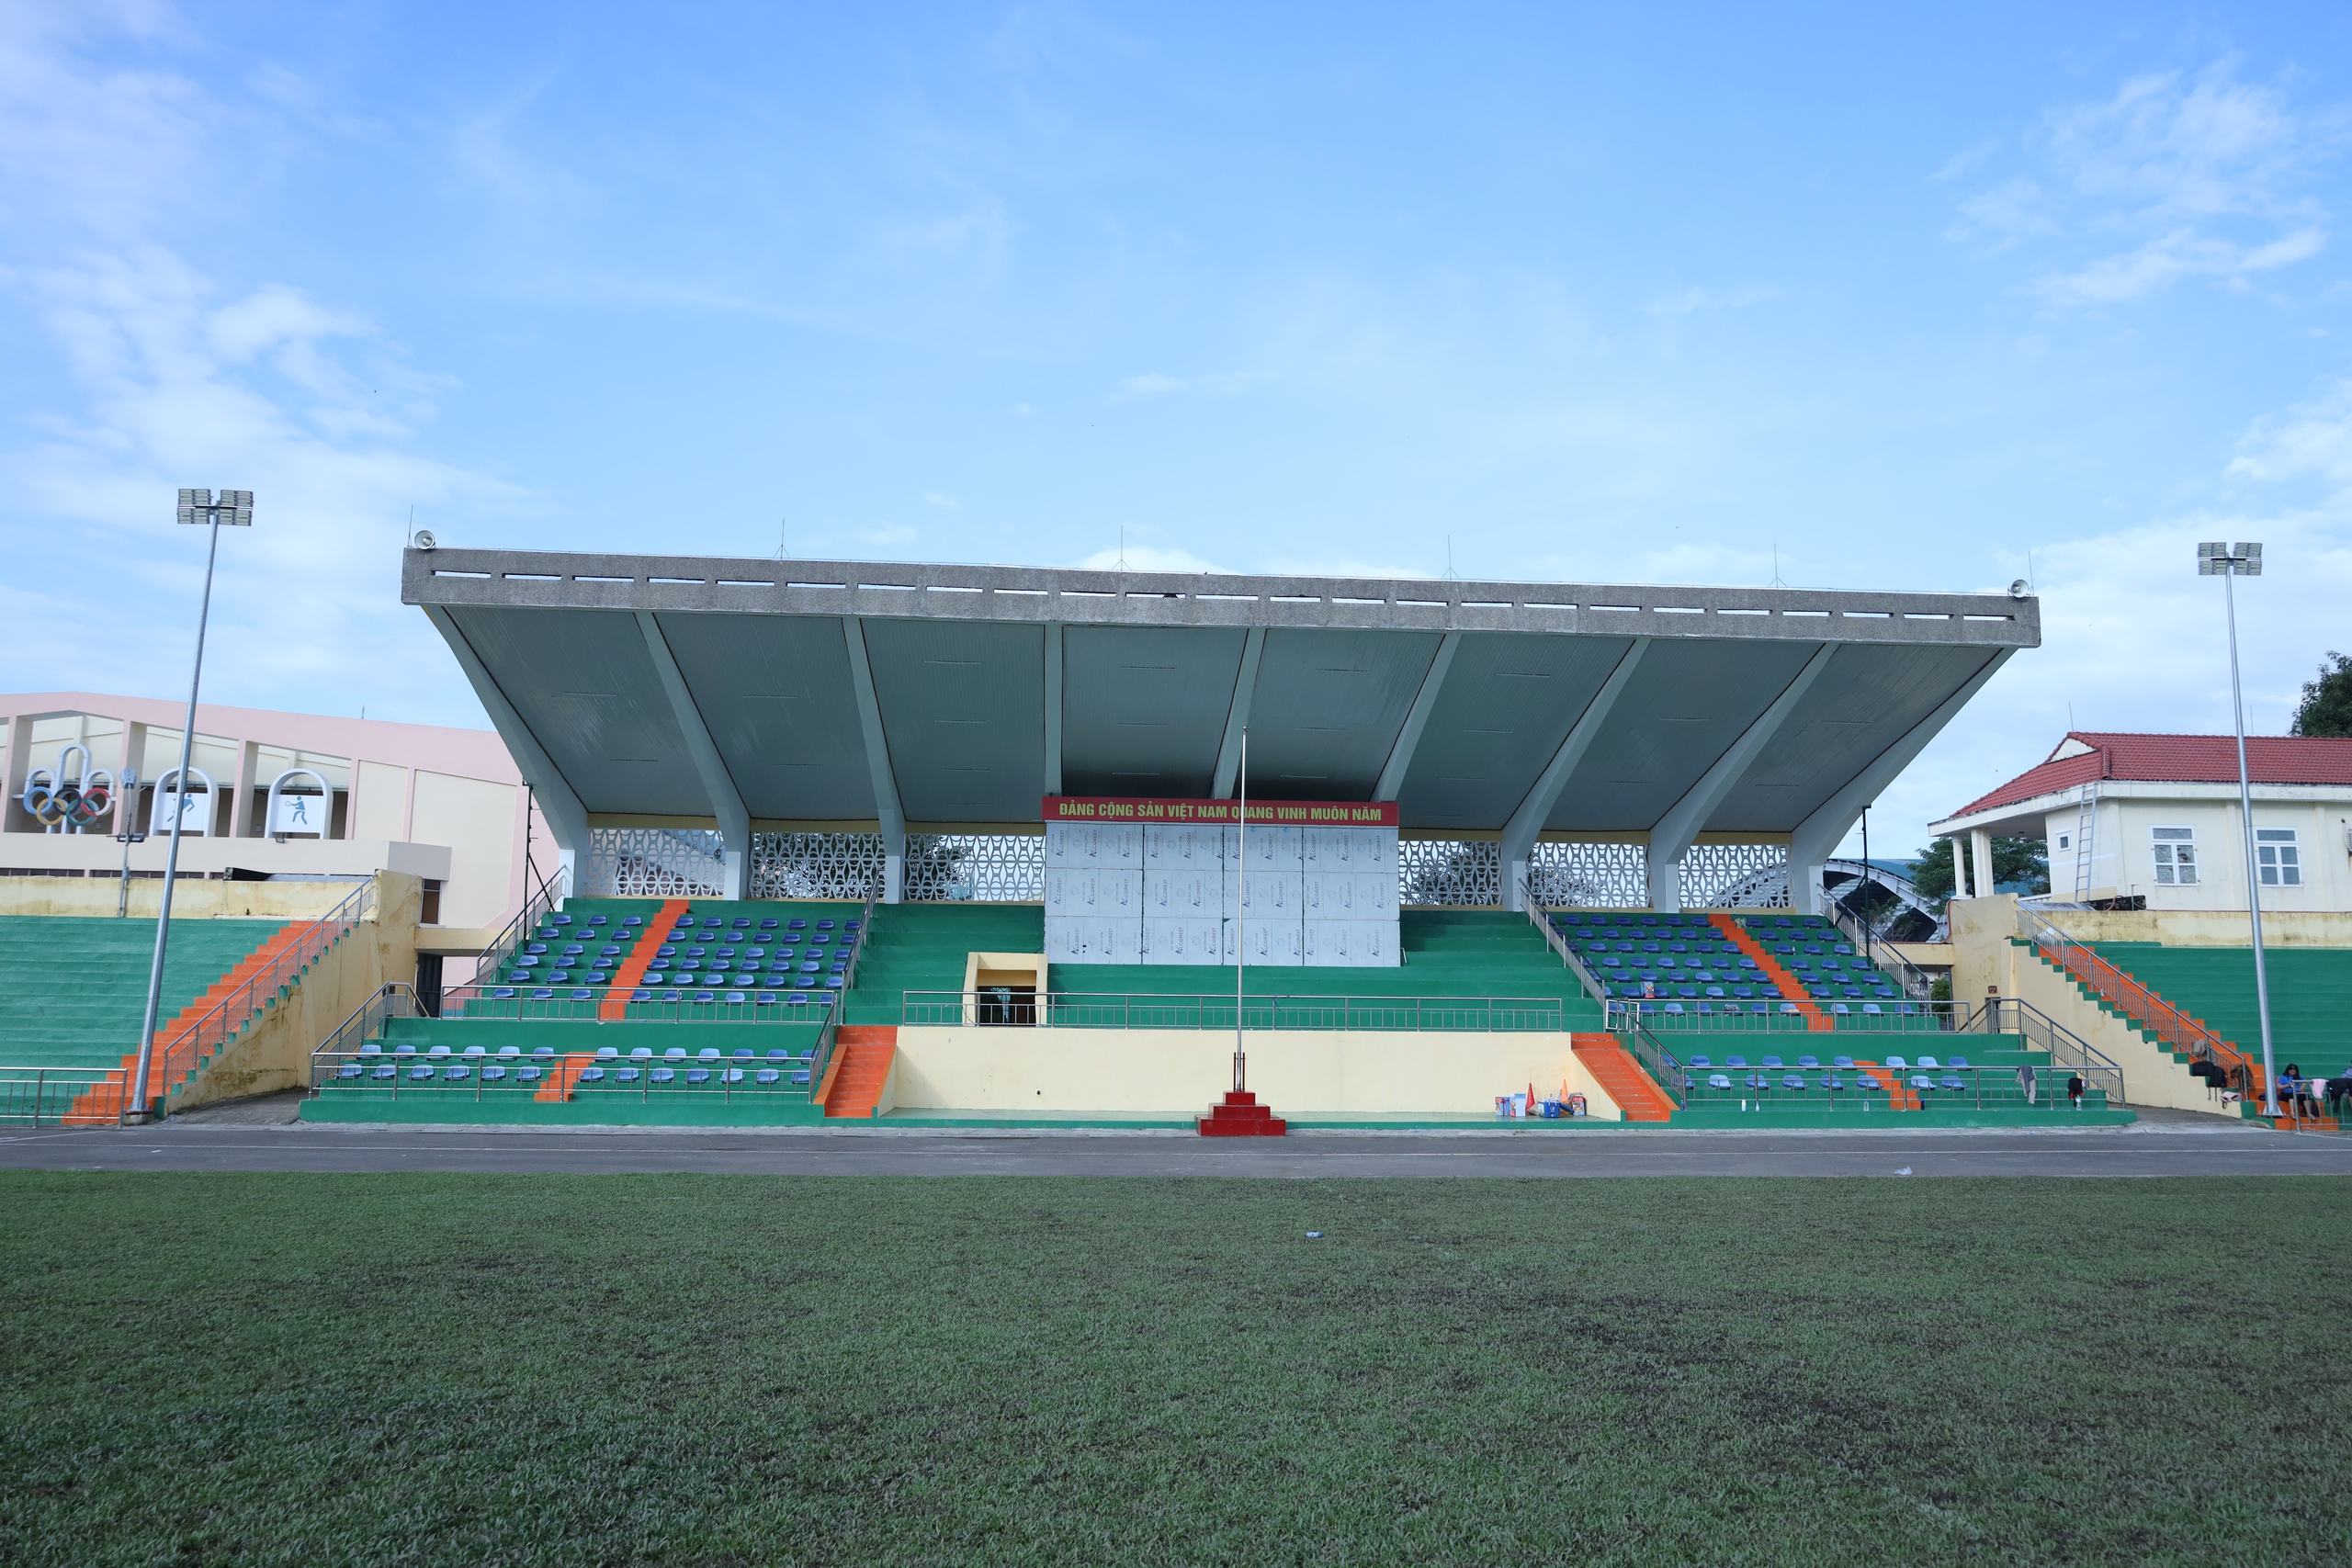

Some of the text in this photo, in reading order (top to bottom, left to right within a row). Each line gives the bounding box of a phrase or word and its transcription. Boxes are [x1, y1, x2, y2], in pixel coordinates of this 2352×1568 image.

[1059, 799, 1094, 816] ĐẢNG
[1099, 802, 1133, 818] CỘNG
[1137, 801, 1163, 817] SẢN
[1168, 803, 1193, 819] VIỆT
[1198, 806, 1227, 818] NAM
[1277, 807, 1306, 819] VINH
[1311, 807, 1348, 820] MUÔN
[1352, 807, 1381, 820] NĂM
